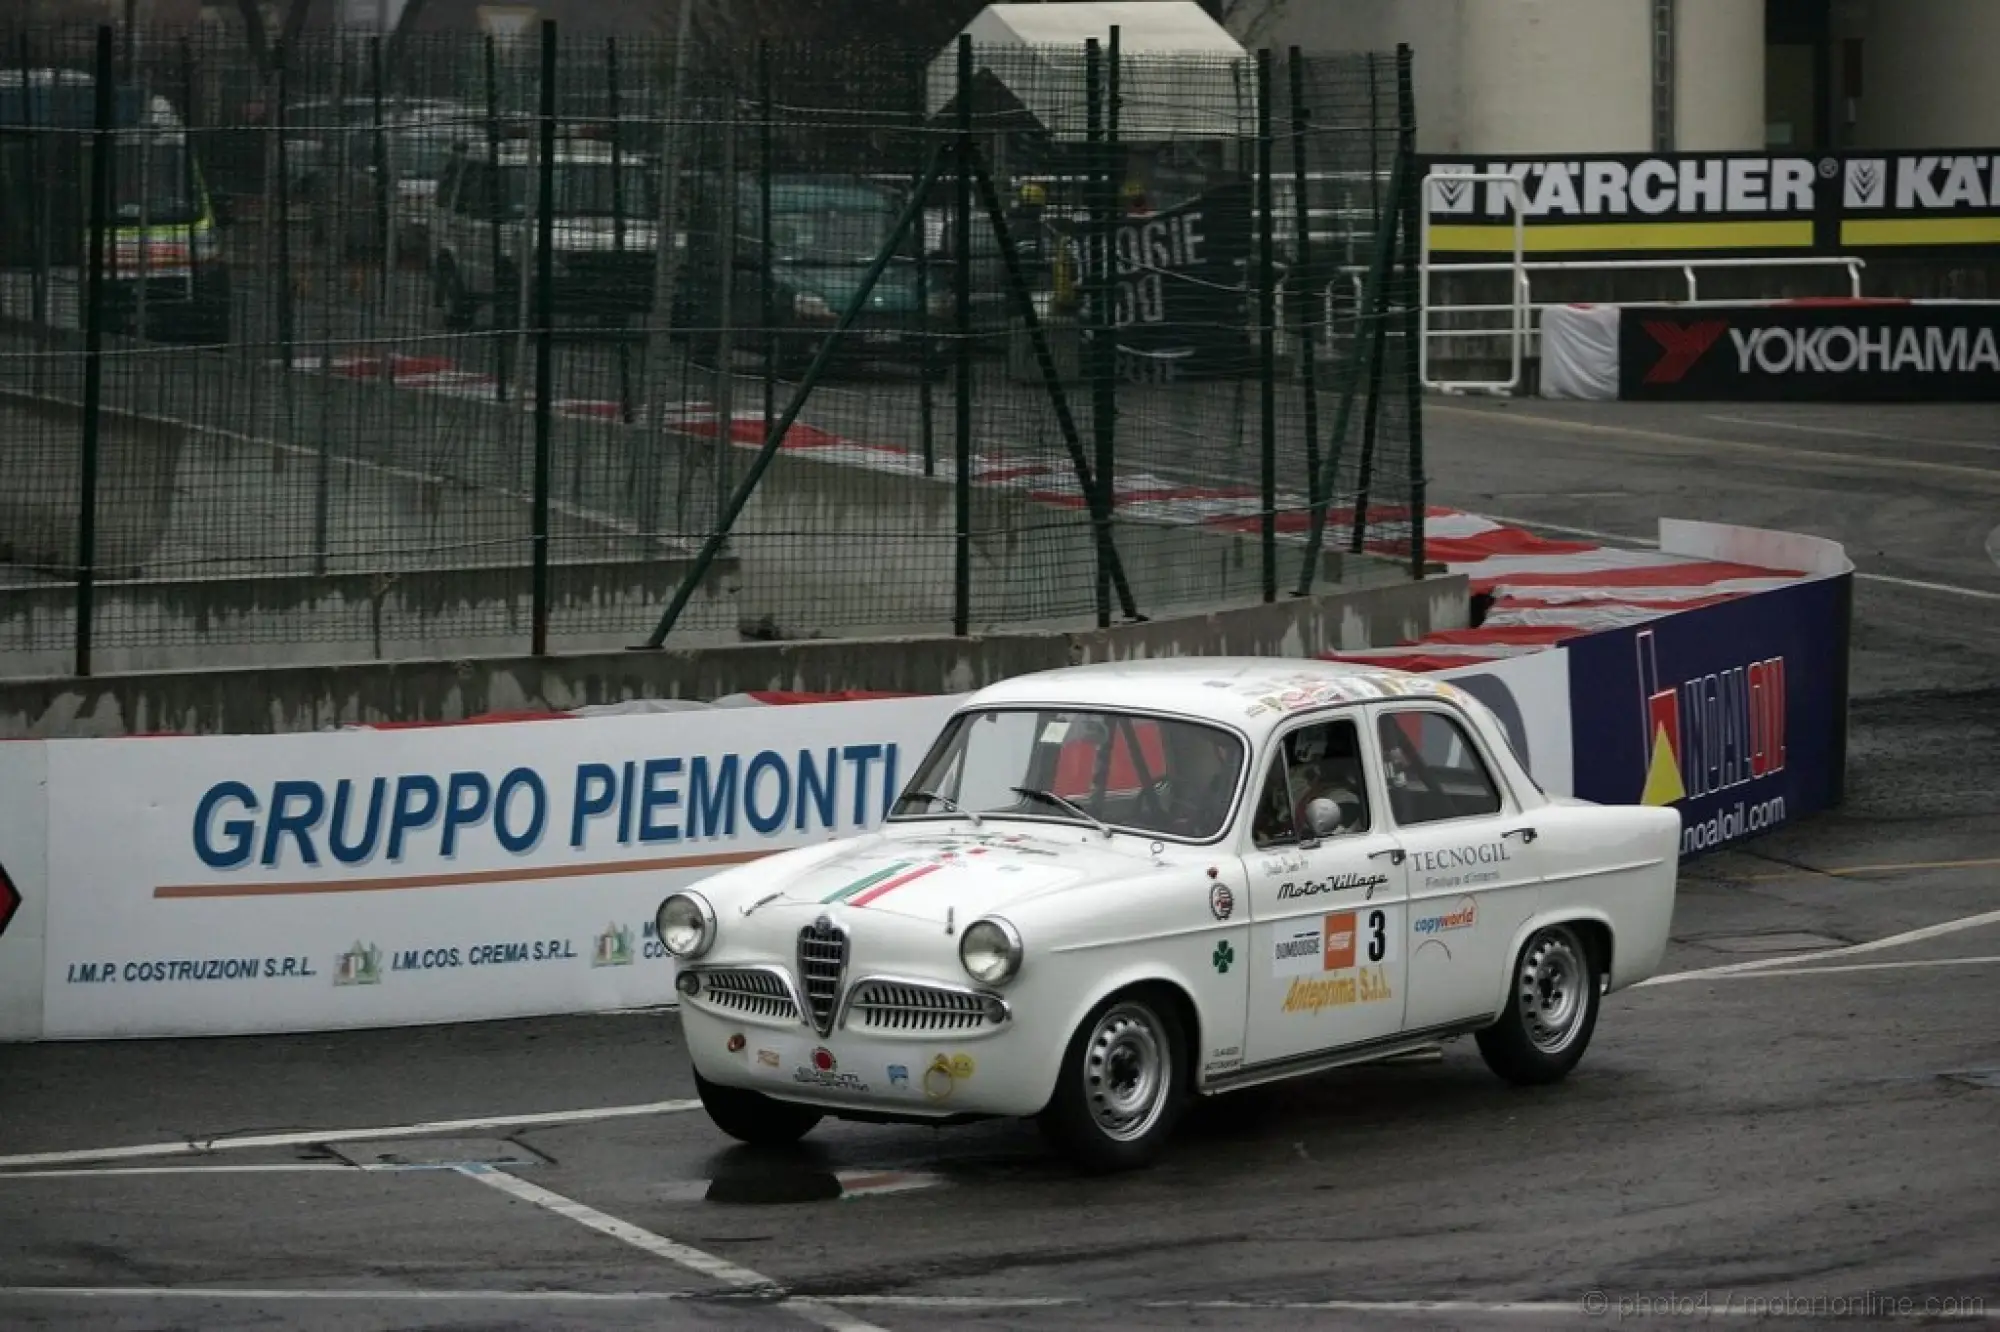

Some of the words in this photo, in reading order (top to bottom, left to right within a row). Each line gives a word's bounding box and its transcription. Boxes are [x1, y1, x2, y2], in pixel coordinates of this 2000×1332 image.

[1728, 326, 2000, 374] YOKOHAMA
[192, 766, 547, 870] GRUPPO
[1410, 842, 1511, 872] TECNOGIL
[468, 943, 529, 966] CREMA
[1368, 909, 1386, 962] 3
[67, 963, 117, 983] I.M.P.
[123, 958, 259, 982] COSTRUZIONI
[263, 956, 317, 977] S.R.L.
